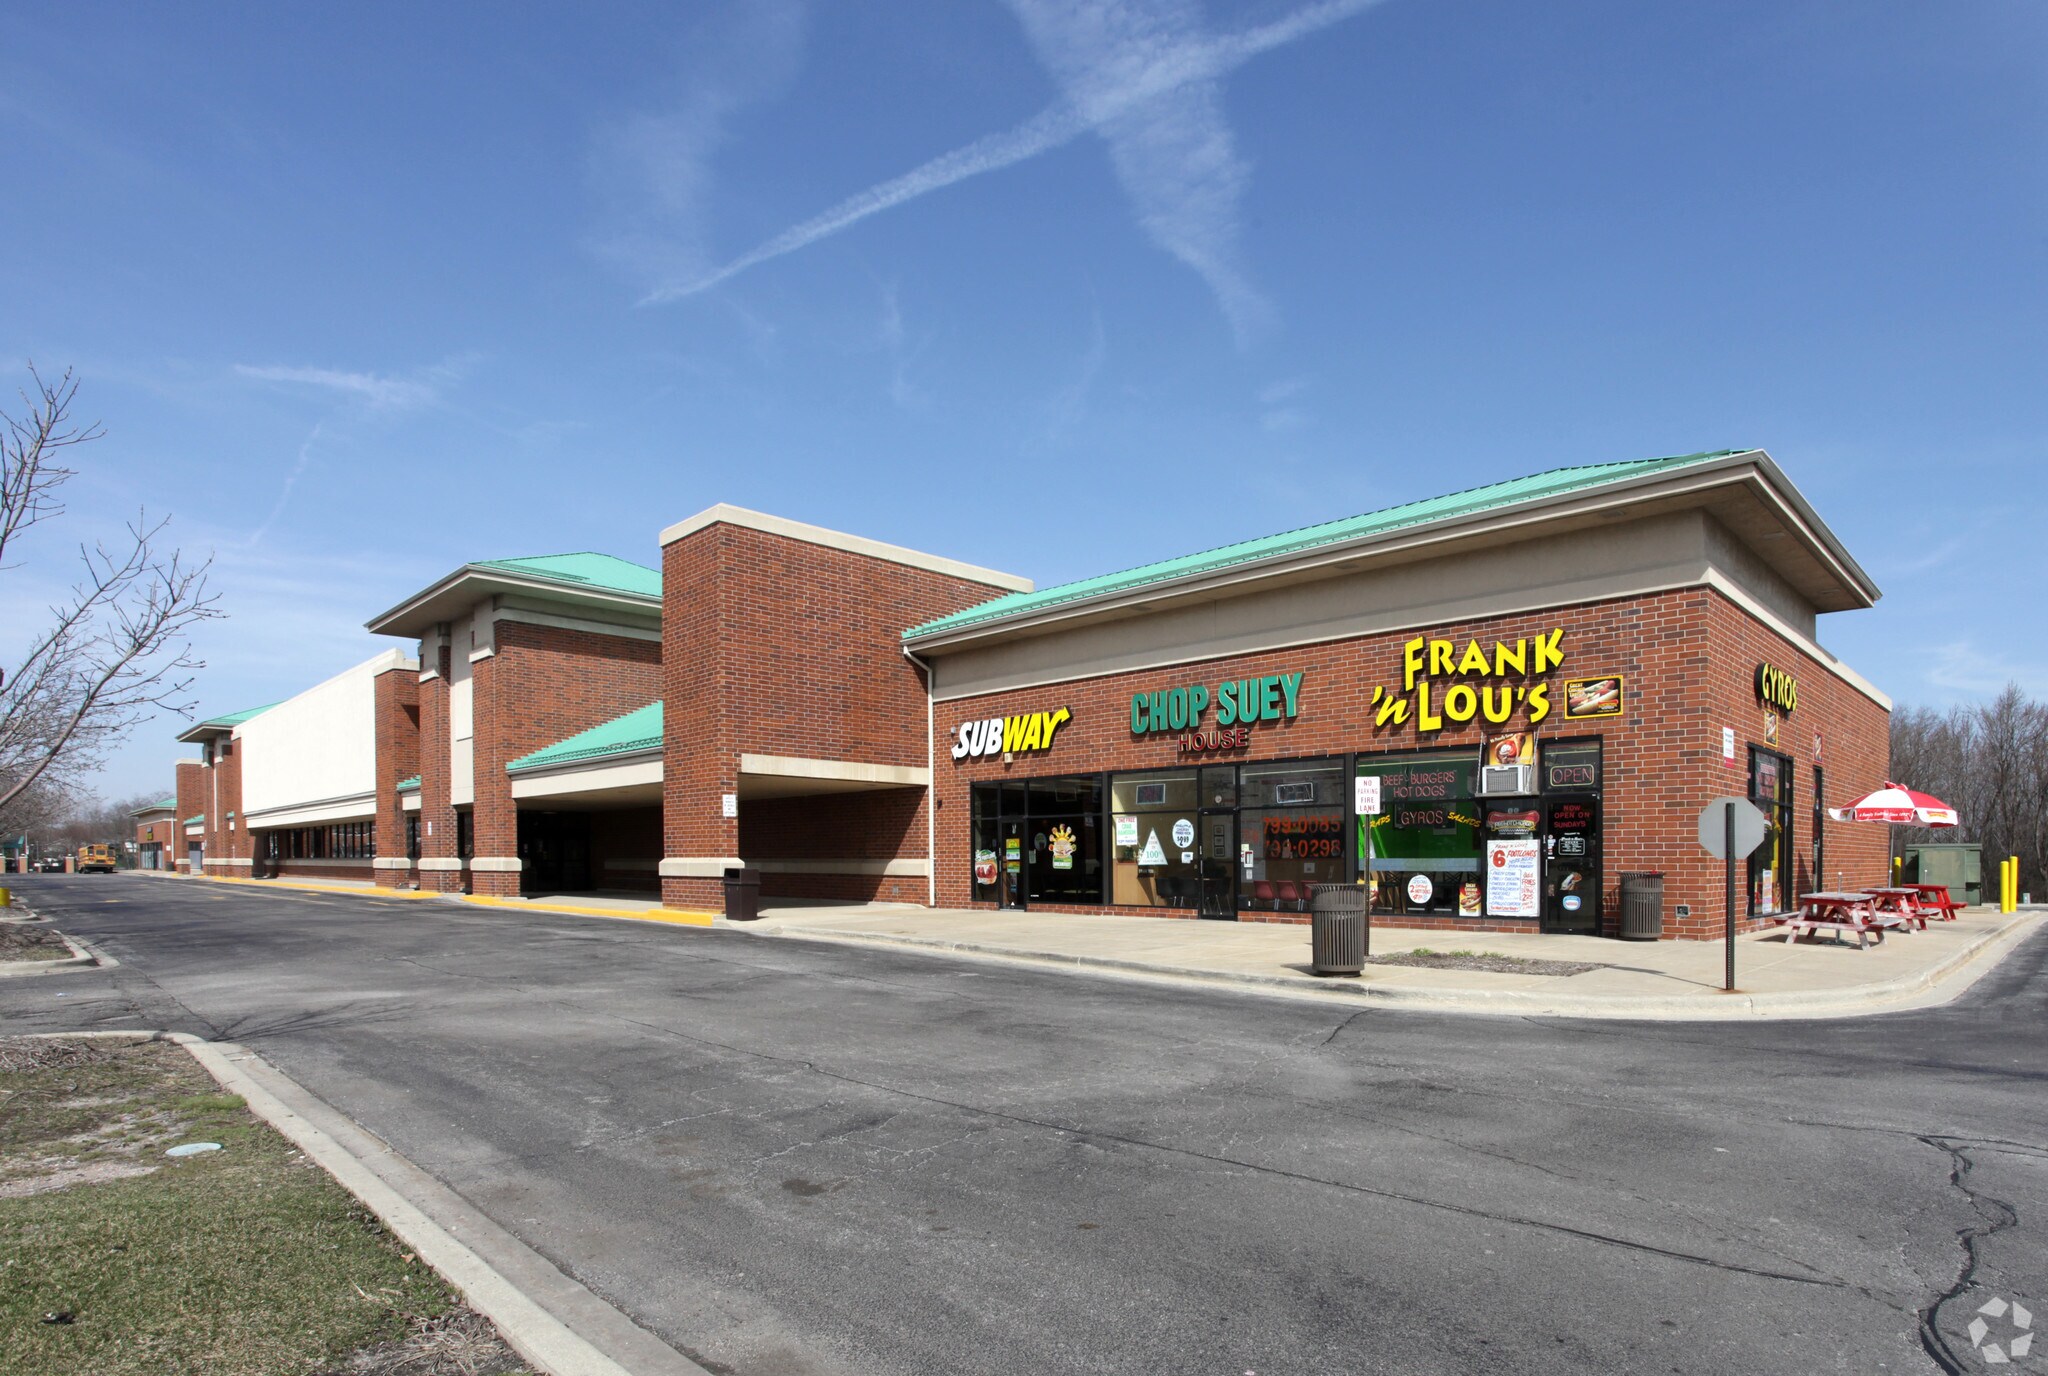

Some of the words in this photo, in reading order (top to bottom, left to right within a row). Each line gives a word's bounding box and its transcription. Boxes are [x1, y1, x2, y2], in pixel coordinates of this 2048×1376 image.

[1404, 627, 1565, 691] FRANK
[1761, 662, 1797, 712] GYROS
[1131, 685, 1210, 734] CHOP
[1217, 672, 1303, 725] SUEY
[1418, 682, 1550, 732] LOU'S
[951, 706, 1070, 760] SUBWAY
[1178, 727, 1249, 751] HOUSE
[1382, 774, 1404, 786] BEEF
[1410, 770, 1455, 785] BURGERS
[1552, 768, 1592, 784] OPEN
[1393, 786, 1413, 798] HOT
[1415, 785, 1446, 797] DOGS
[1362, 814, 1391, 828] RAPS
[1401, 810, 1444, 826] GYROS
[1447, 811, 1482, 828] SALADS
[1554, 820, 1586, 829] SUNDAYS
